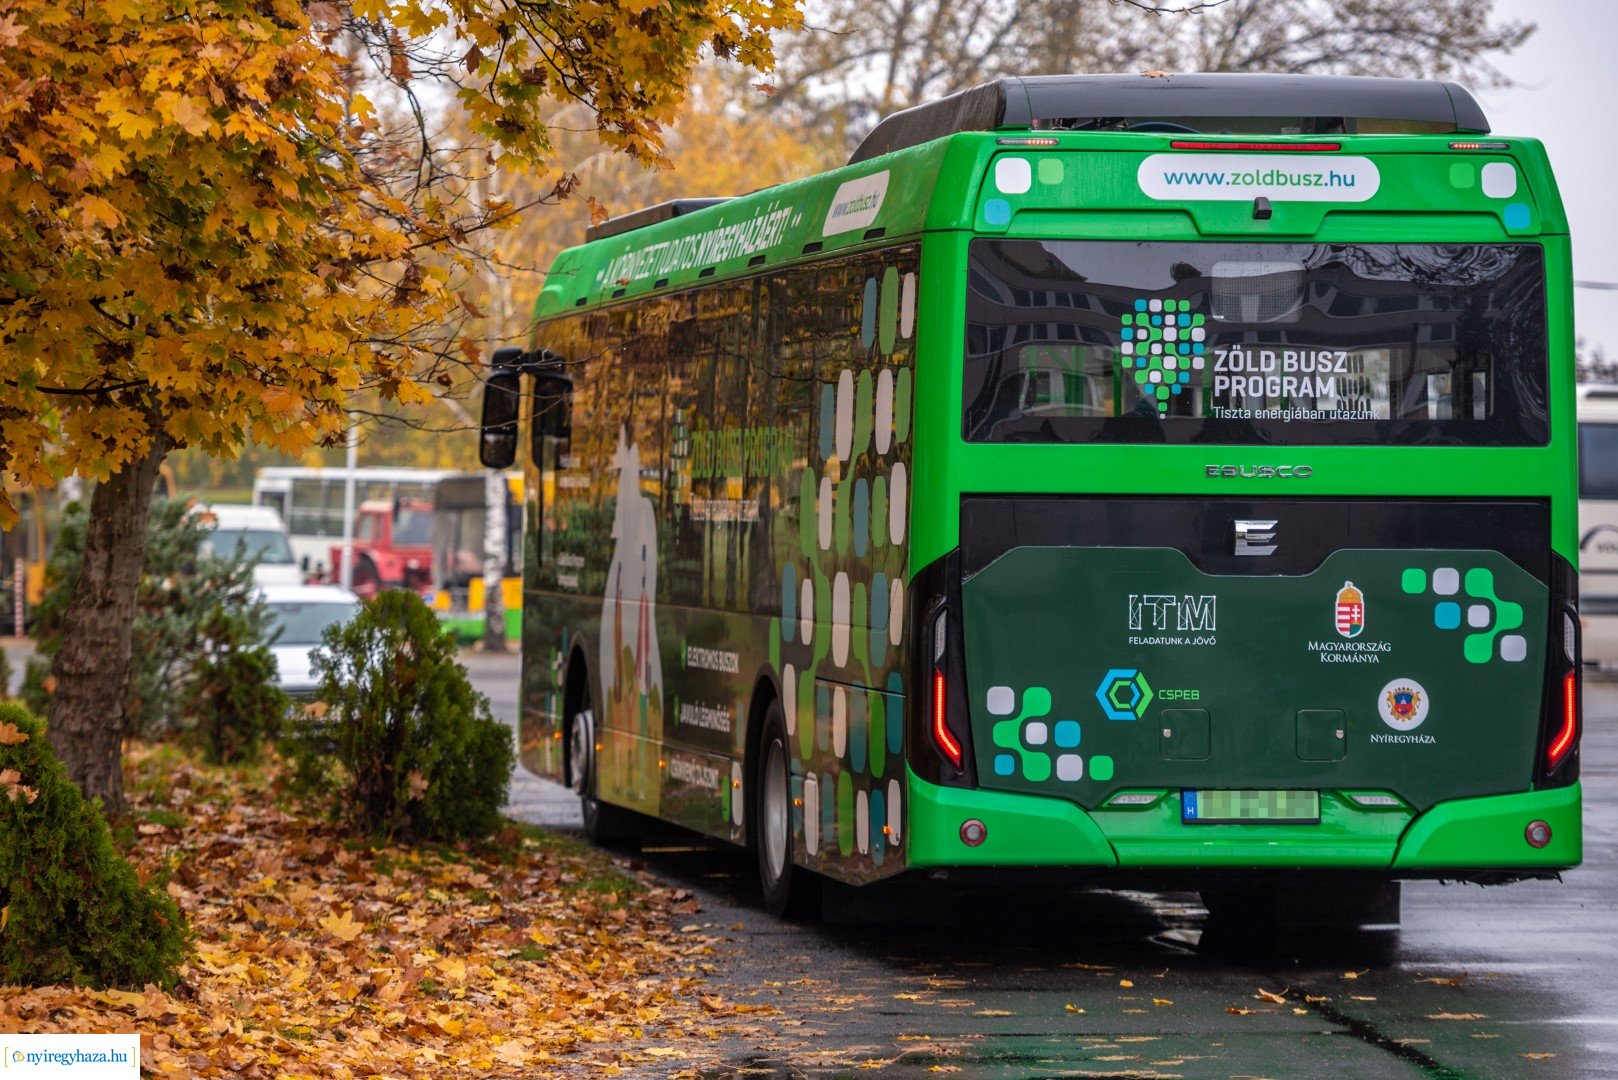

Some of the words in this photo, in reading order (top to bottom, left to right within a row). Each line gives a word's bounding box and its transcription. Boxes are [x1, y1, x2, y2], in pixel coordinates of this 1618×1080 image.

[1164, 169, 1355, 187] www.zoldbusz.hu
[1214, 344, 1276, 372] ZÖLD
[1283, 350, 1348, 373] BUSZ
[1214, 375, 1335, 398] PROGRAM
[1213, 406, 1251, 419] Tiszta
[1255, 406, 1325, 422] energiában
[1329, 408, 1380, 420] utazunk
[1205, 464, 1313, 479] EBUSCO
[1128, 594, 1217, 631] ITM
[1128, 637, 1183, 645] FELADATUNK
[1184, 637, 1191, 645] A
[1192, 636, 1217, 646] JÖVŐ
[1308, 641, 1391, 652] MAGYARORSZÁG
[1320, 652, 1380, 663] KORMÁNYA
[1158, 689, 1200, 700] CSPEB
[1370, 733, 1436, 744] NYÍREGYHÁZA
[1187, 807, 1194, 815] H
